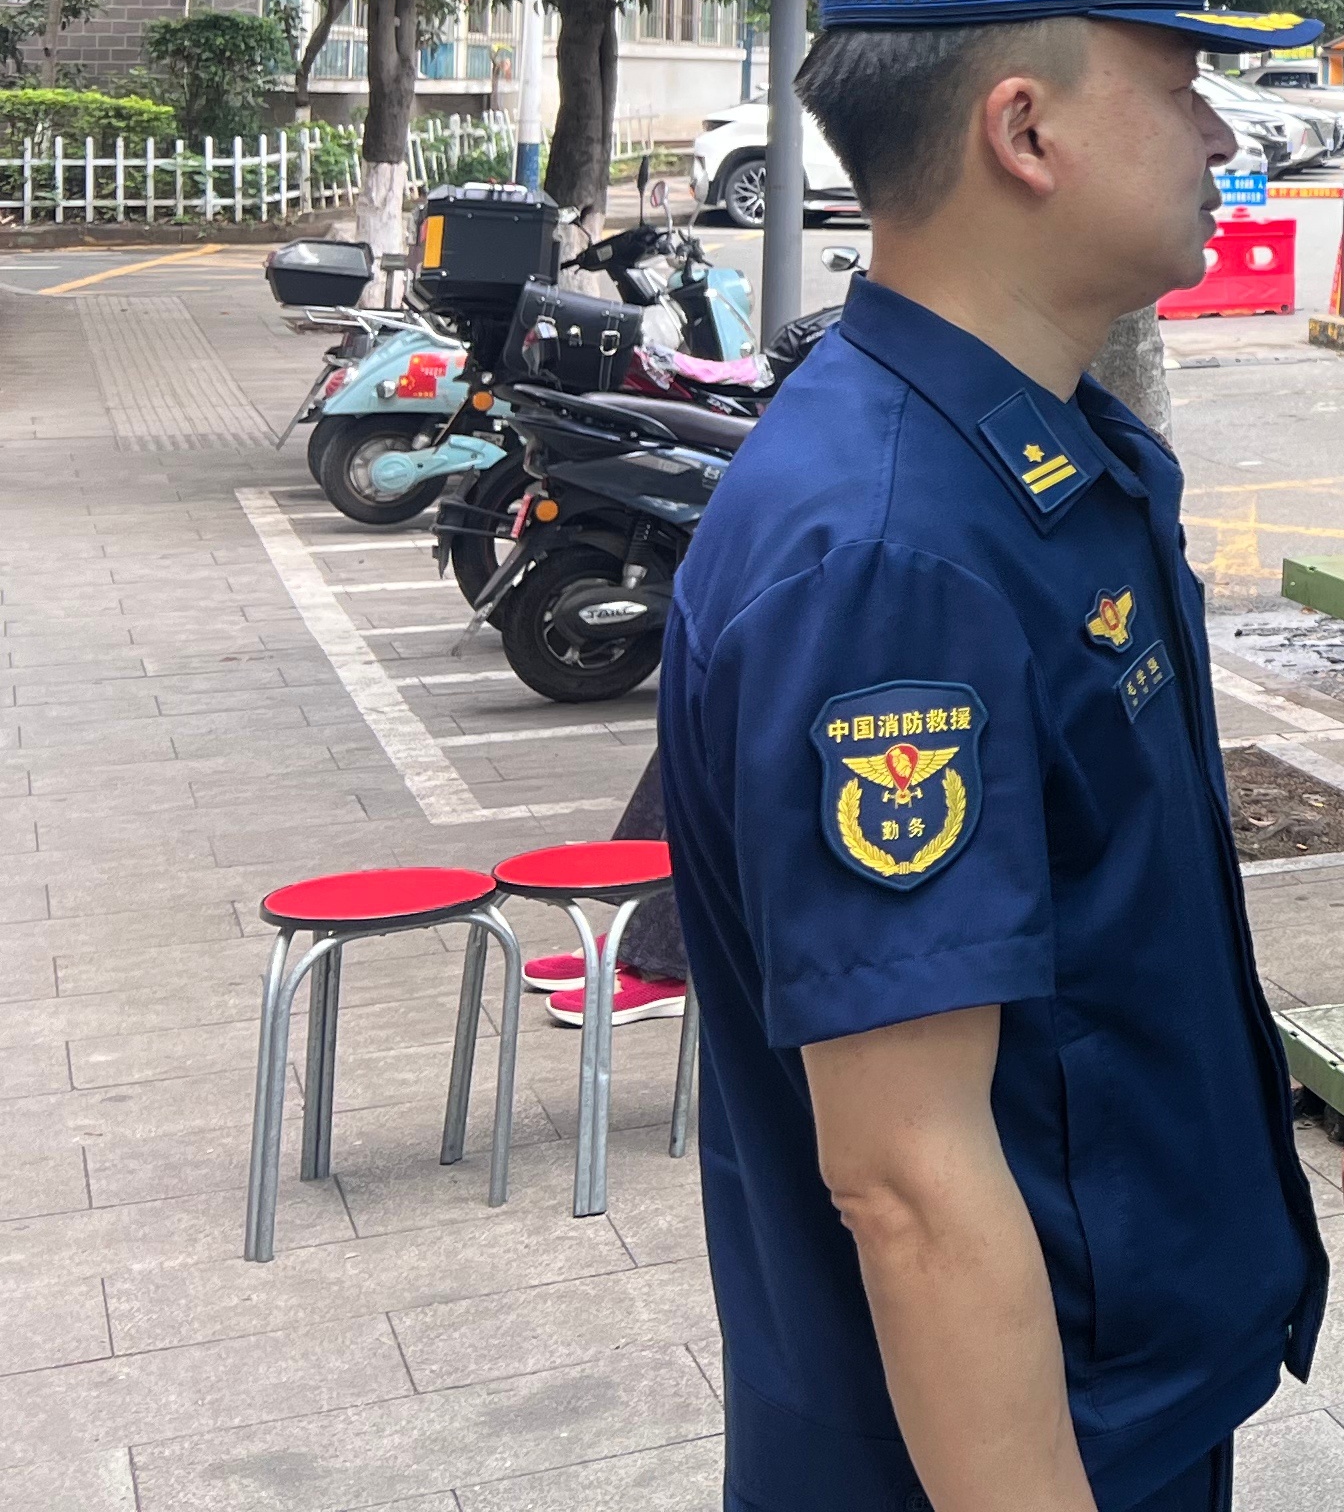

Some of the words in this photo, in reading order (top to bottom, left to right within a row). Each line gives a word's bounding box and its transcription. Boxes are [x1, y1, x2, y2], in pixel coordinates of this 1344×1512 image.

[827, 707, 972, 743] 中国消防救援
[882, 817, 926, 840] 勤务
